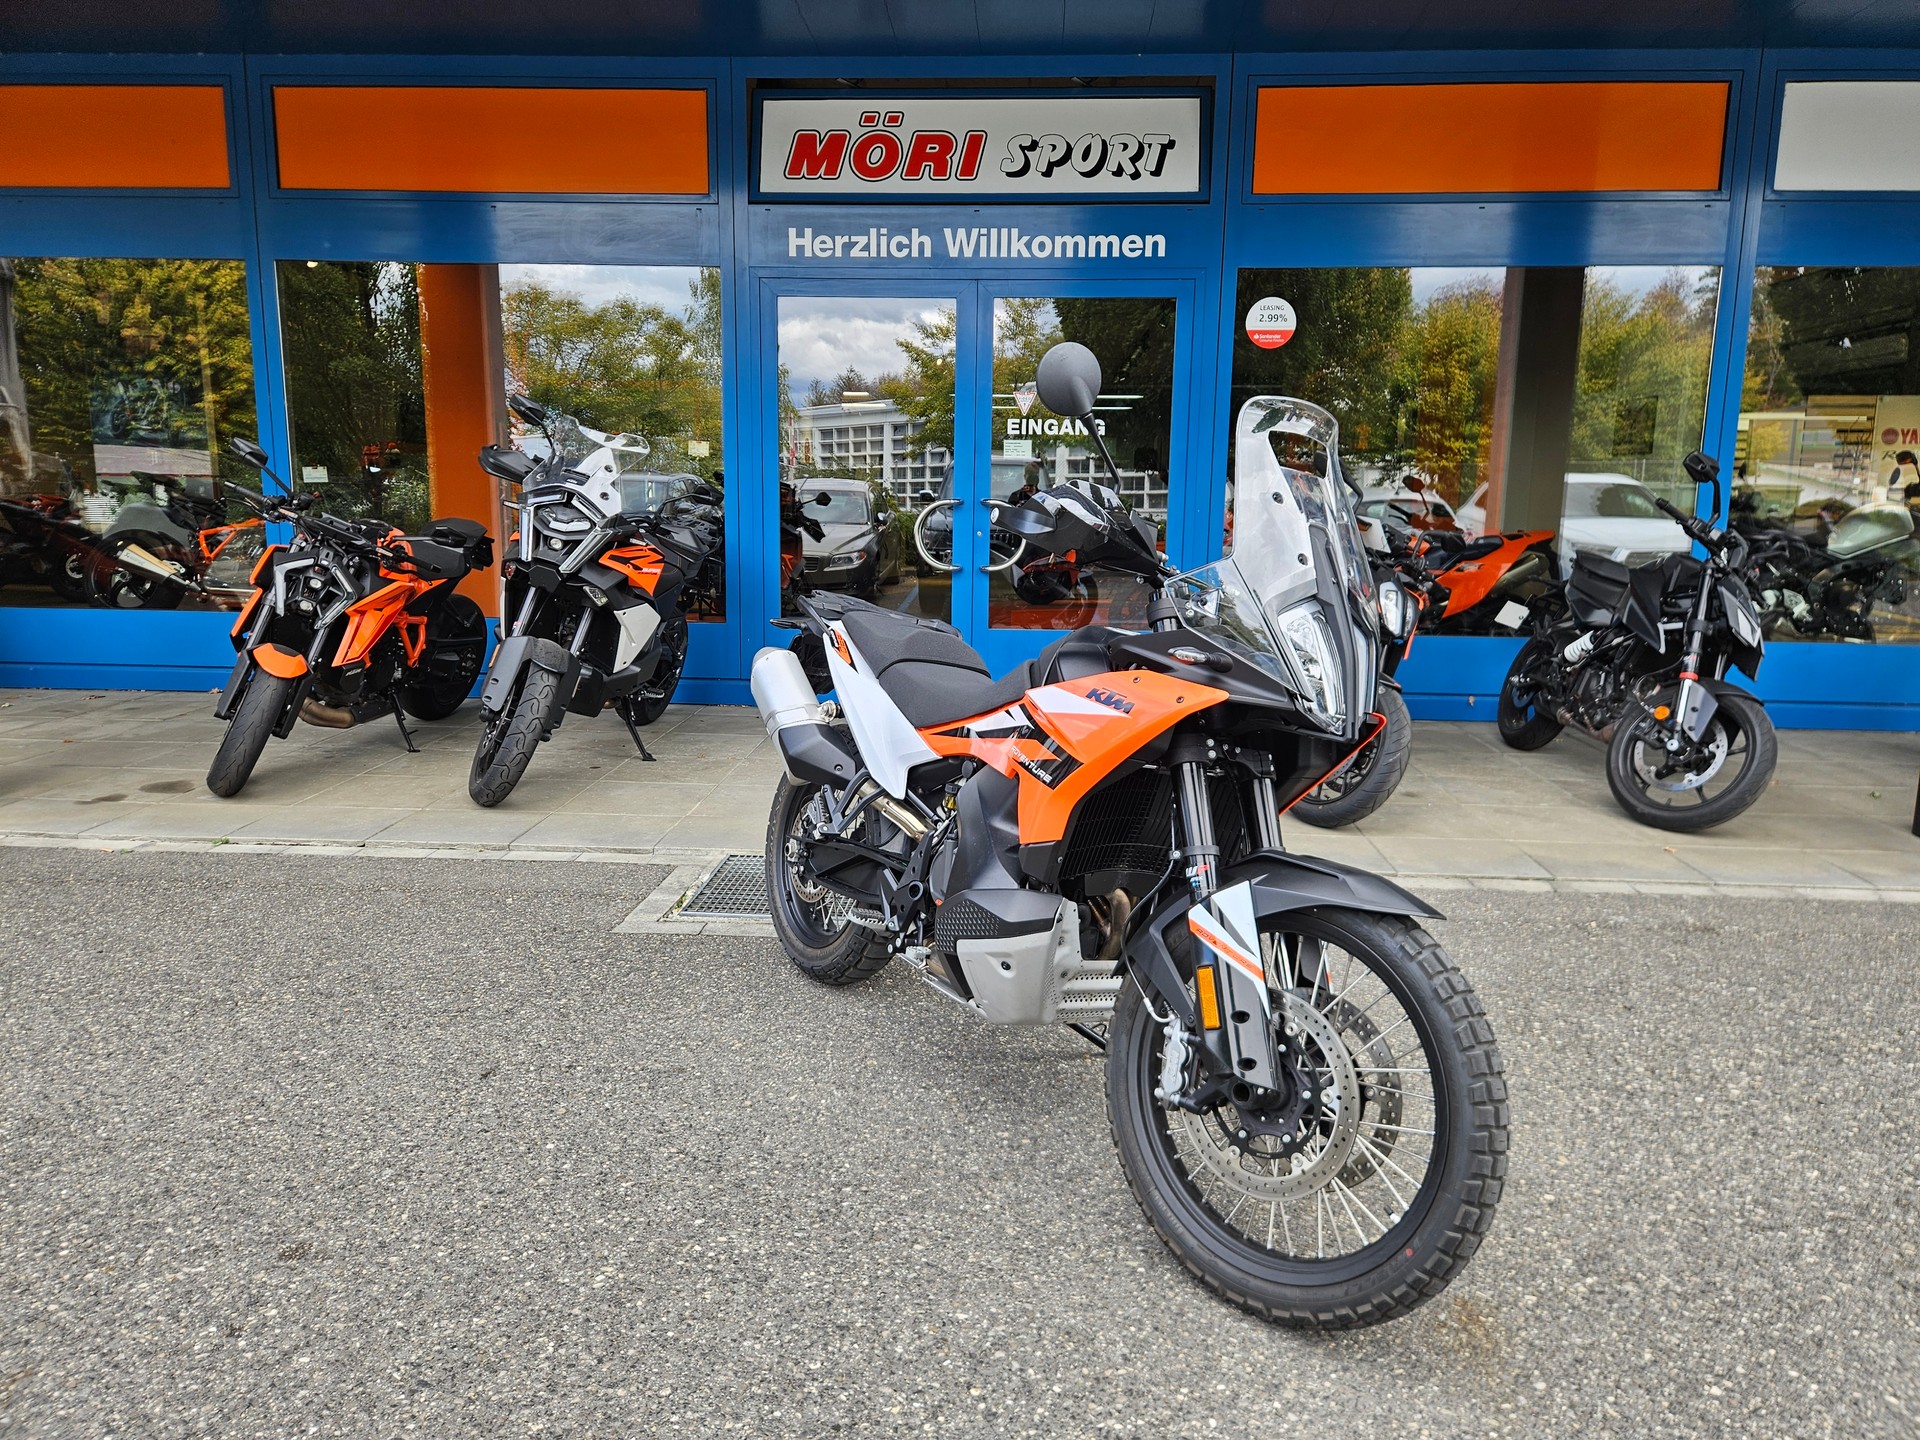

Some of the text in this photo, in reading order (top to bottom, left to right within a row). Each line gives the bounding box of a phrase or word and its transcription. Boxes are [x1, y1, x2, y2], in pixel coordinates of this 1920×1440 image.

[783, 111, 1176, 182] MÖRI SPORT
[787, 227, 1166, 258] Herzlich Willkommen
[1259, 314, 1287, 322] 2.99%
[1900, 428, 1920, 444] YA
[1085, 687, 1136, 714] KTM
[1009, 744, 1054, 784] ADVENTURE
